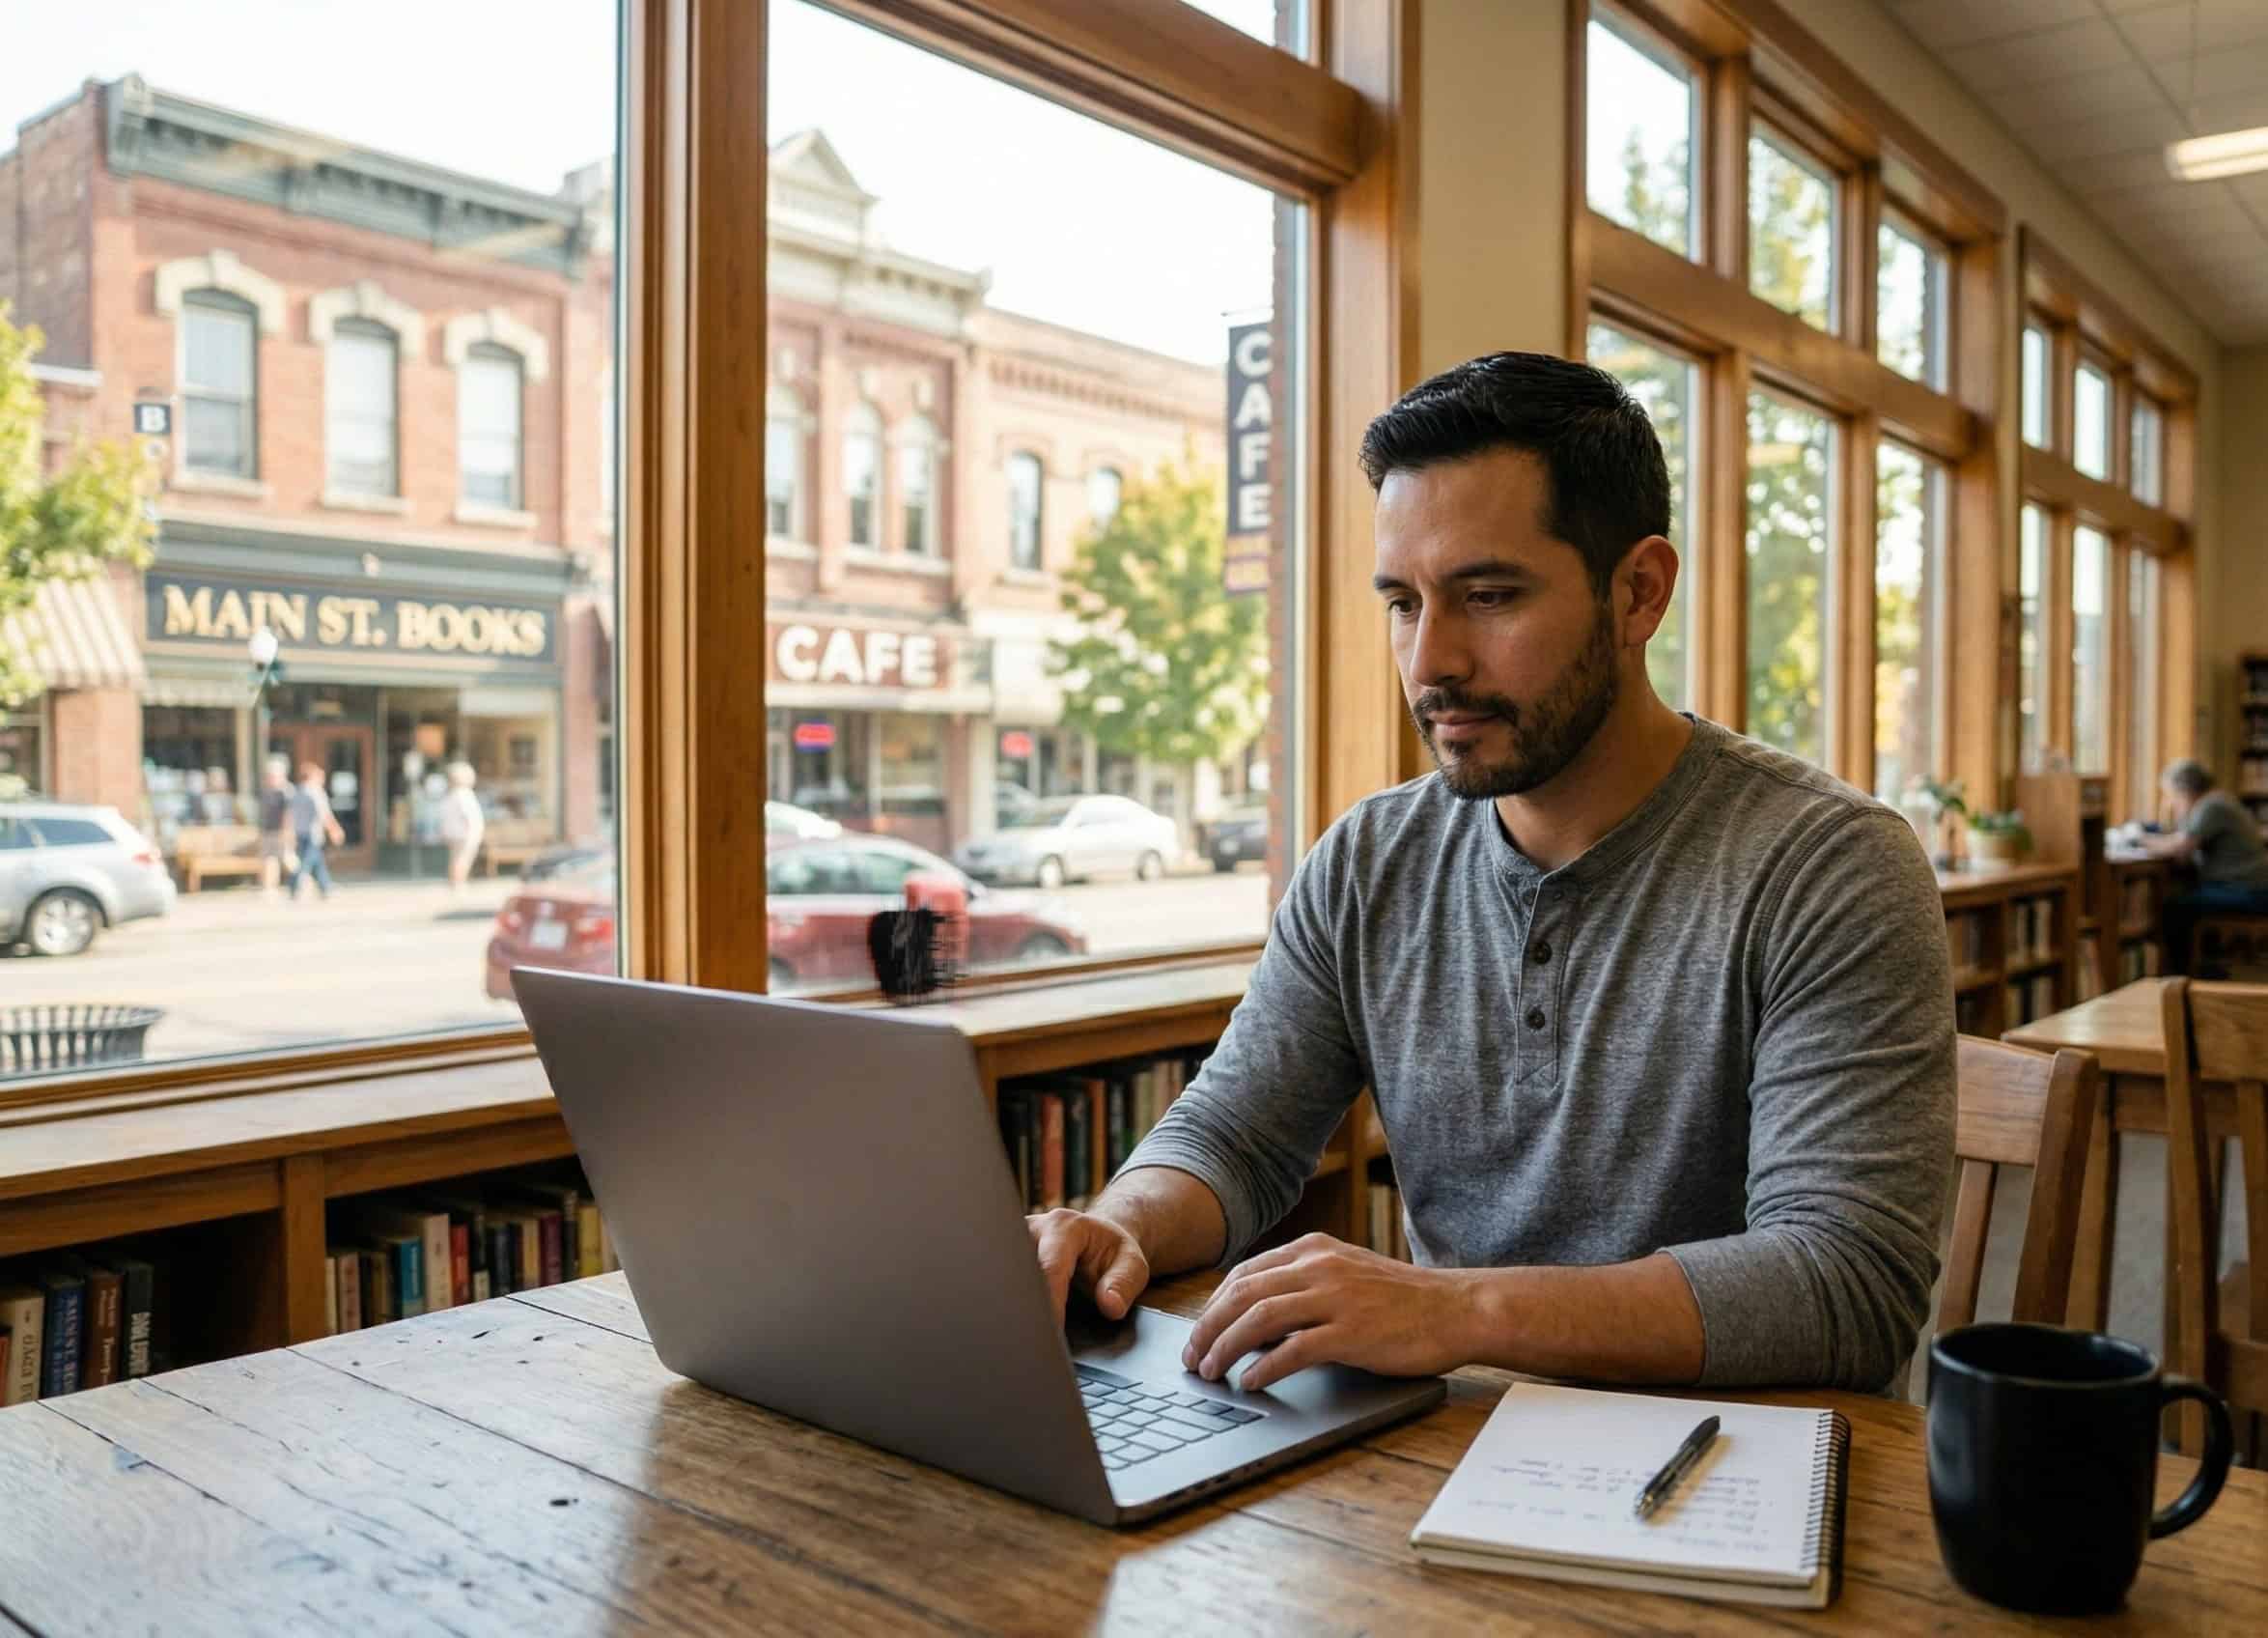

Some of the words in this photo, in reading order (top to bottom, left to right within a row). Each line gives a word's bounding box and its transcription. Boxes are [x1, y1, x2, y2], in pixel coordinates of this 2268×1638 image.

[141, 406, 165, 433] B
[1235, 330, 1274, 529] CAFE
[164, 584, 308, 640] MAIN
[318, 595, 385, 647] ST.
[396, 600, 546, 657] BOOKS
[776, 625, 938, 687] CAFE
